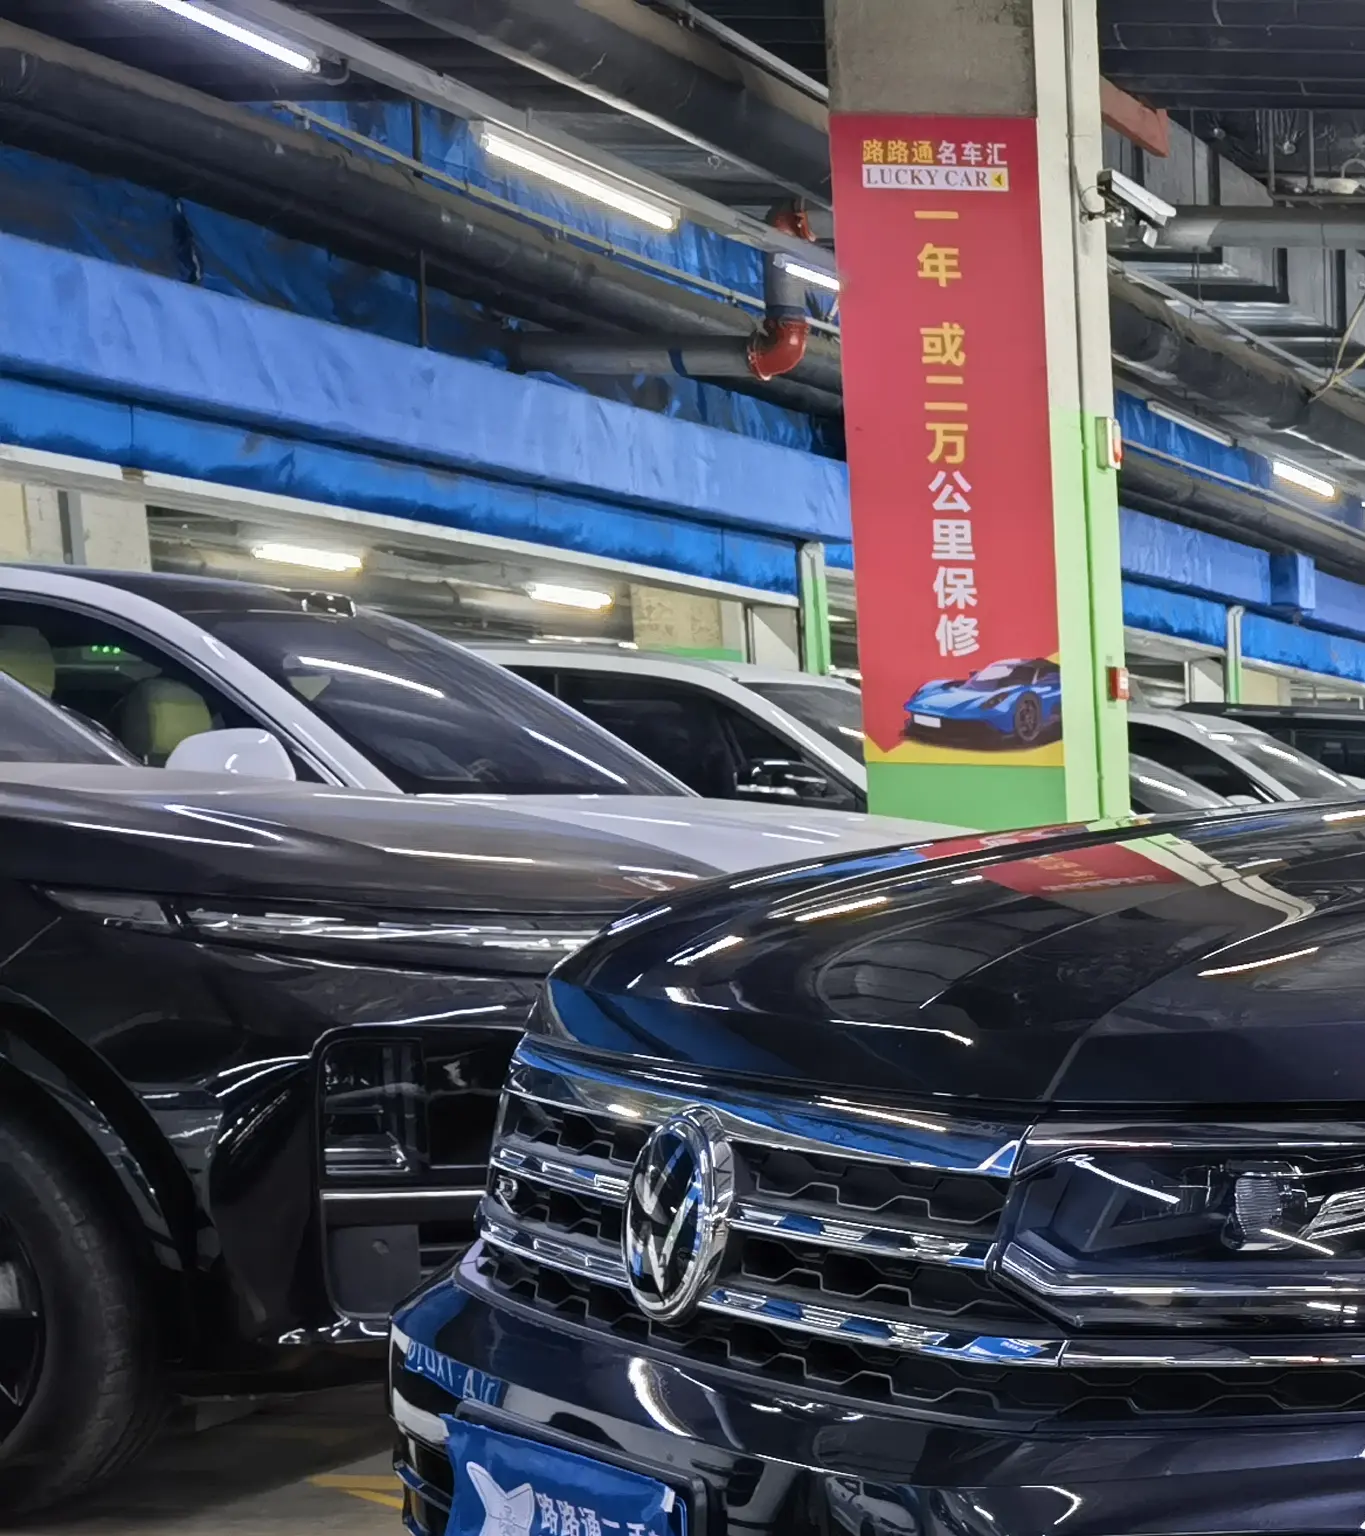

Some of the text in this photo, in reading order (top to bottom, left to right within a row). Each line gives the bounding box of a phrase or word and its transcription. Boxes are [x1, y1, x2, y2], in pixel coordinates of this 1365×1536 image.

[862, 139, 1008, 166] 路路通名车汇
[865, 168, 989, 187] LUCKY CAR
